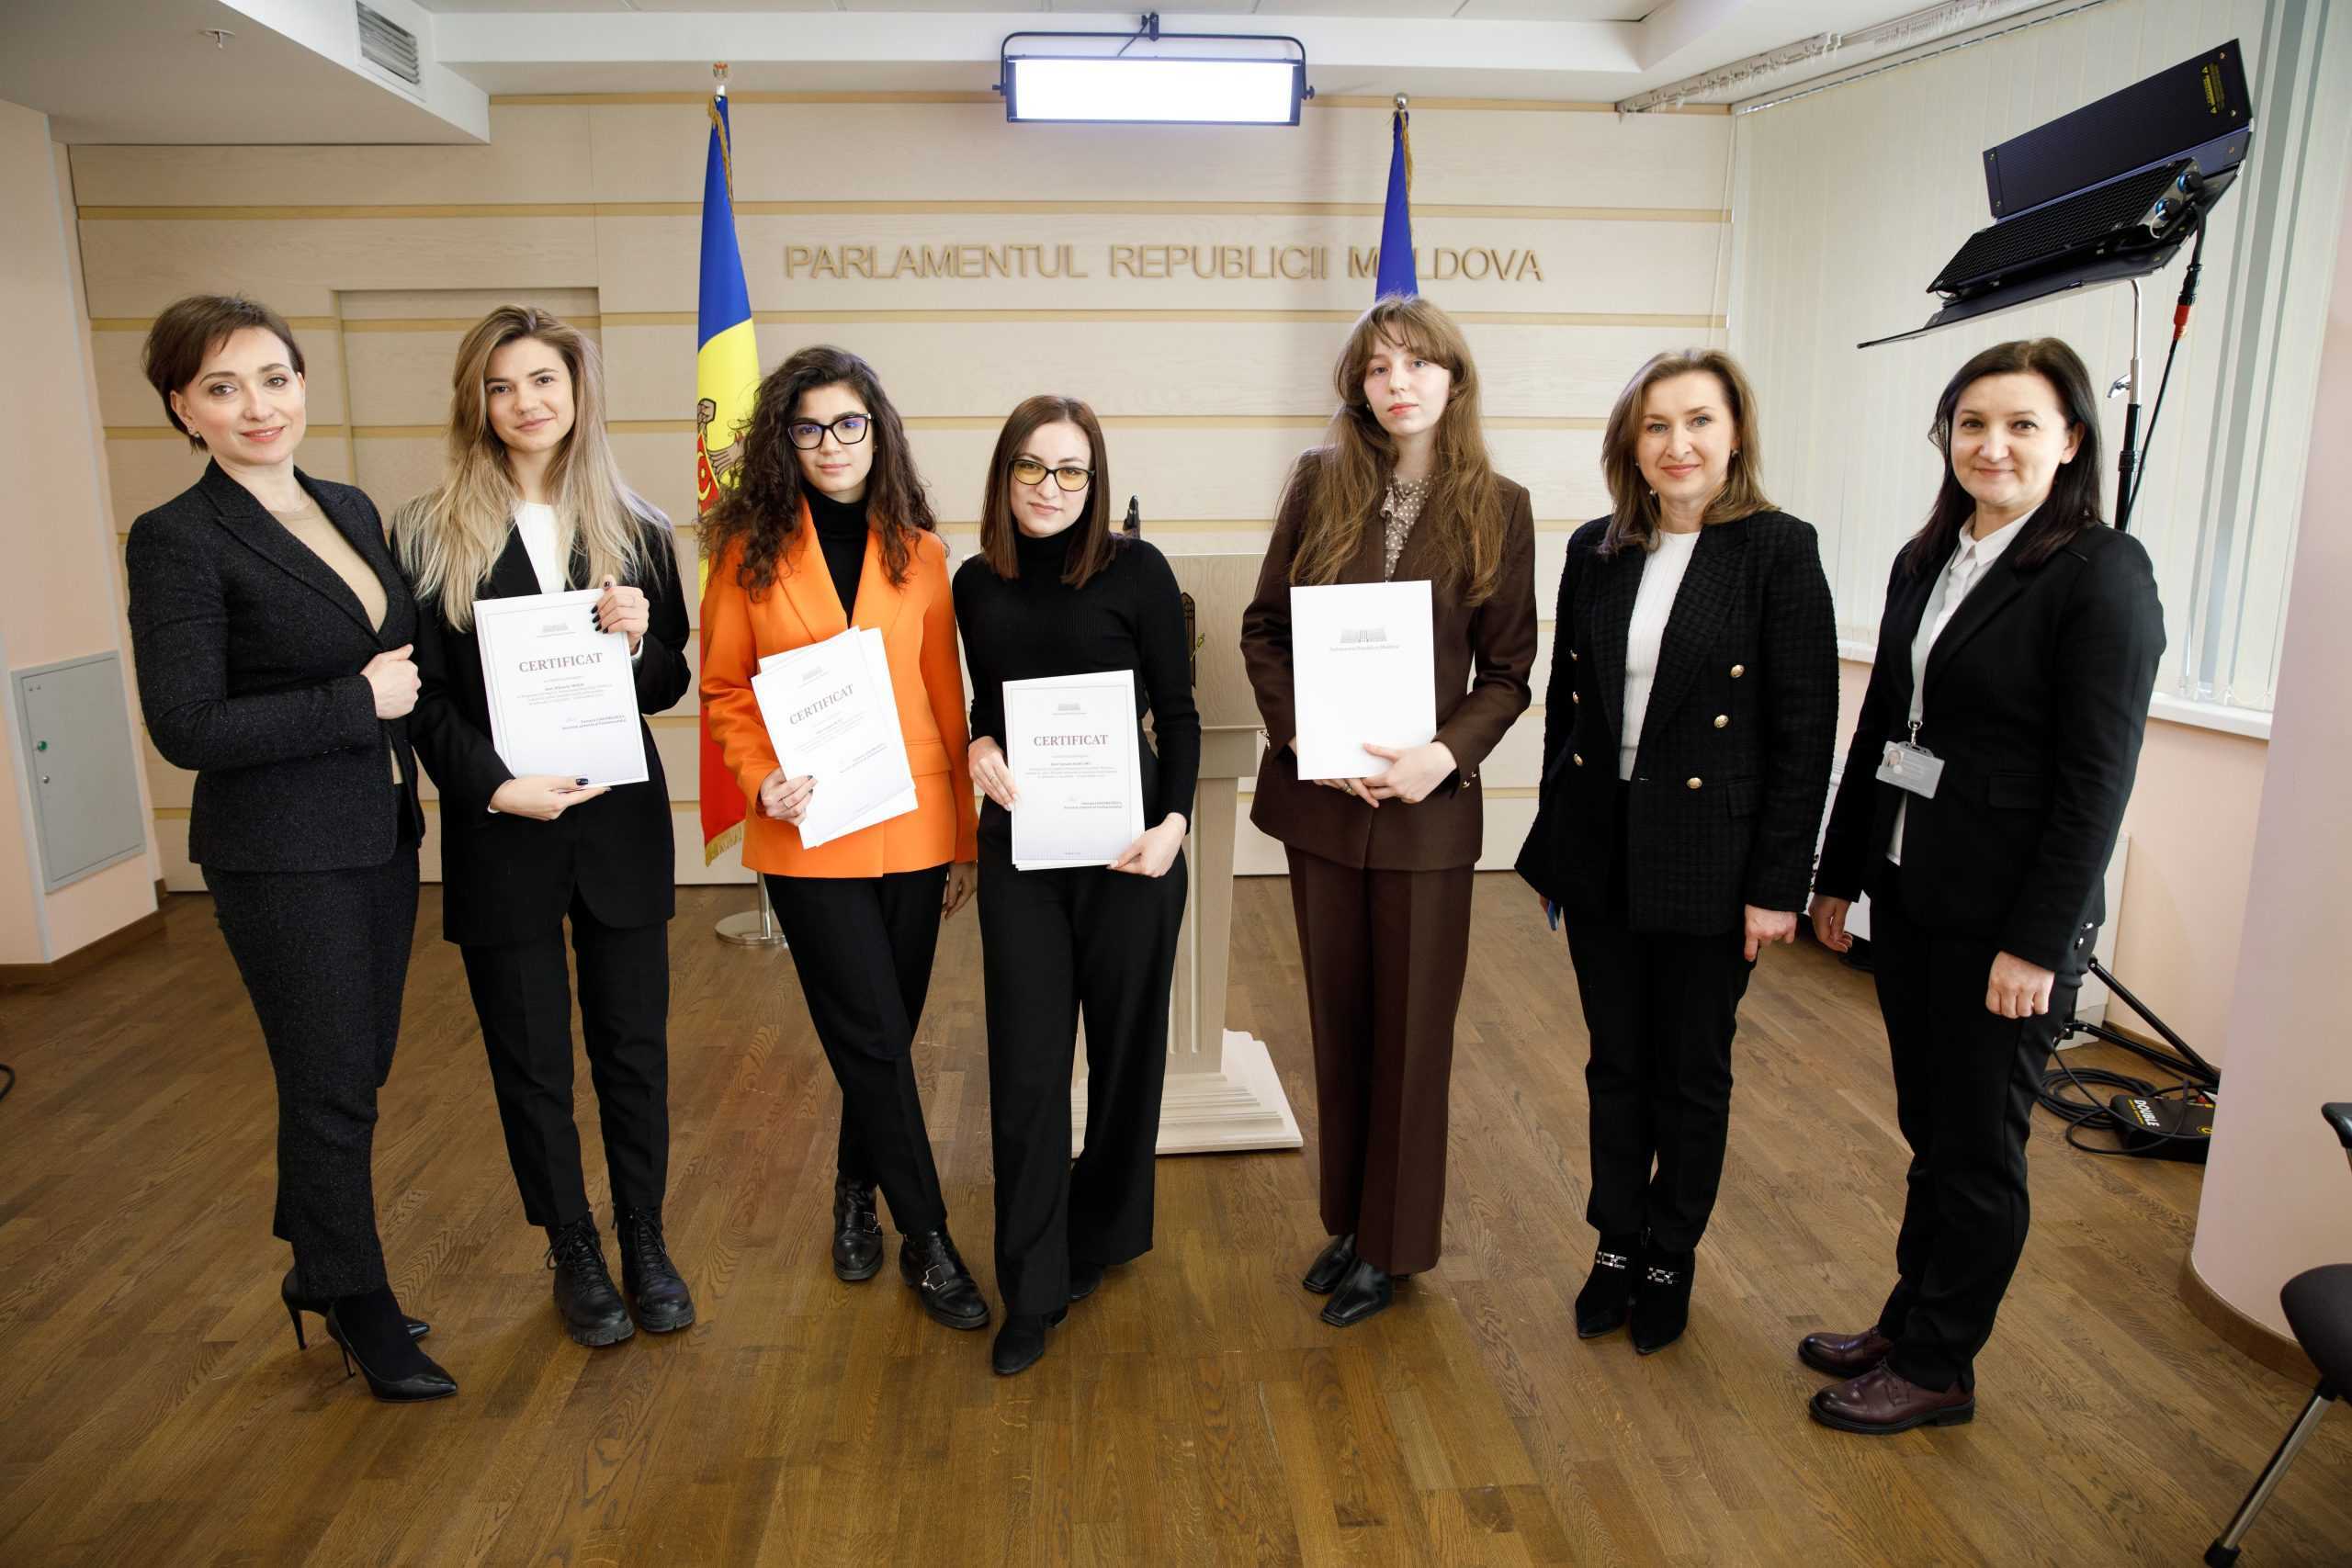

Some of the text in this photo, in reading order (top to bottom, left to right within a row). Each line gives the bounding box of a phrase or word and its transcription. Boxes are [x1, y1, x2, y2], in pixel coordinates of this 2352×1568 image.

[785, 243, 1544, 281] PARLAMENTUL REPUBLICII MLDOVA
[519, 652, 603, 672] CERTIFICAT
[789, 683, 854, 726] CERTIFICAT
[1034, 735, 1108, 746] CERTIFICAT
[2134, 1100, 2159, 1127] DOUBLE
